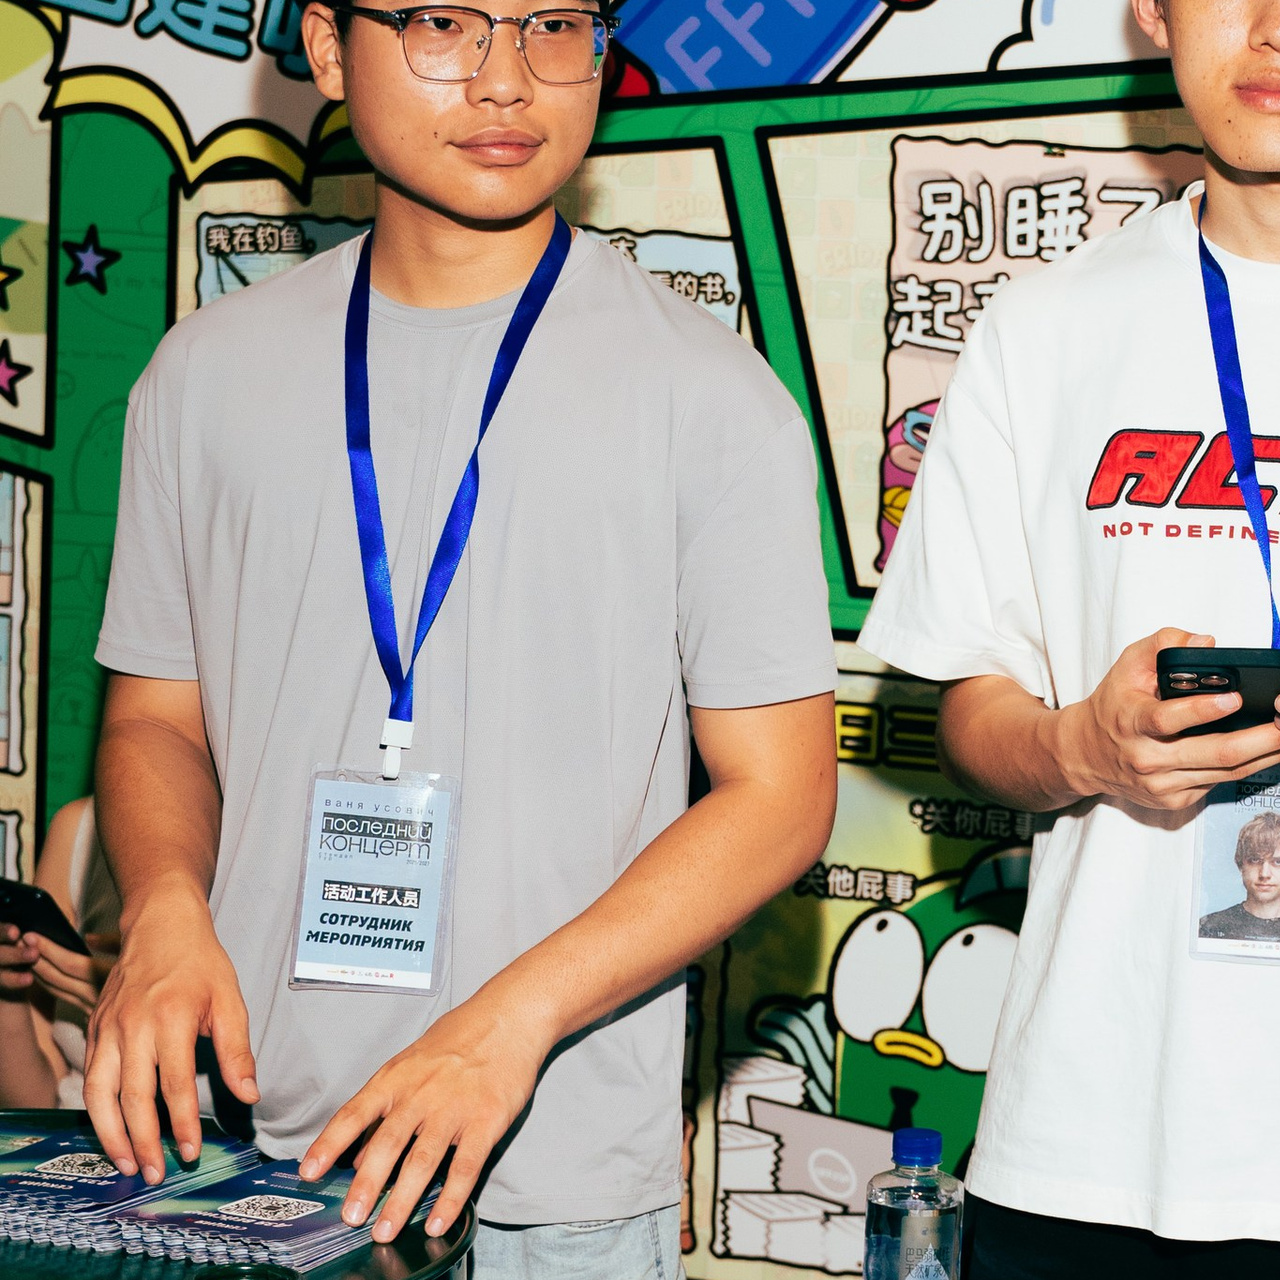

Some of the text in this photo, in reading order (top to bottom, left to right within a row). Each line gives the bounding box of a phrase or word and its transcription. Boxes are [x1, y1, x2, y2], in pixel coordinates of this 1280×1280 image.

[919, 179, 1161, 263] 别睡了
[1103, 521, 1154, 539] NOT
[1165, 524, 1280, 544] DEFINE
[321, 816, 433, 841] последний
[323, 882, 420, 908] 活动工作人员
[319, 912, 414, 933] СОТРУДНИК
[305, 930, 426, 953] МЕРОПРИЯТИЯ
